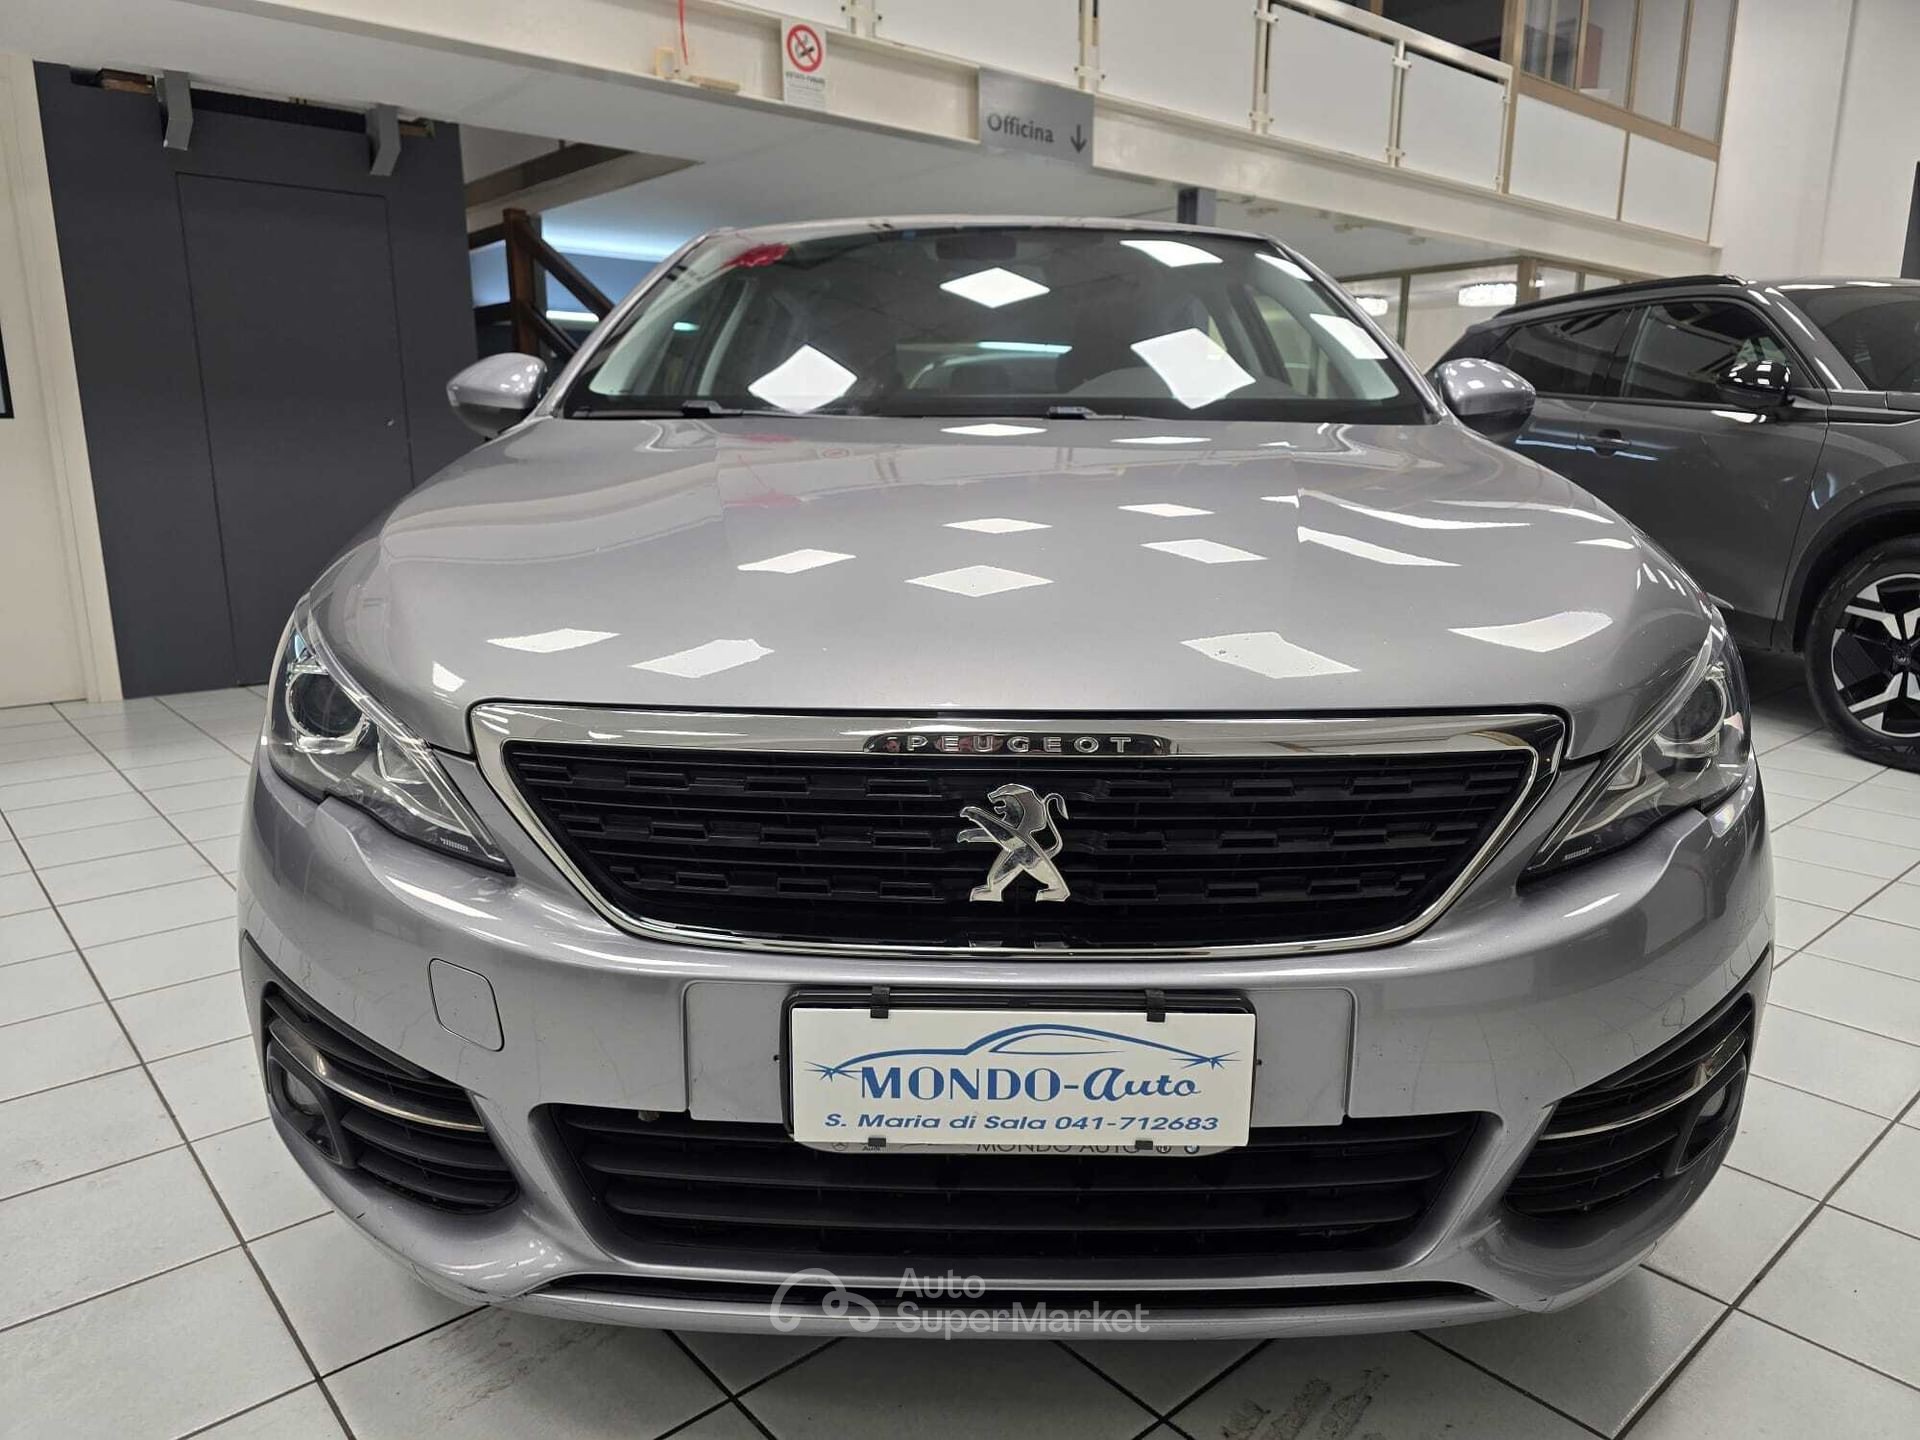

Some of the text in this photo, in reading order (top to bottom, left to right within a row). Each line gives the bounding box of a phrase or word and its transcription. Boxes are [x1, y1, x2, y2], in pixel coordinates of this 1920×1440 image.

[987, 113, 1054, 143] Officina
[906, 735, 1132, 753] PEUGEOT
[861, 1066, 1202, 1101] MONDO-Auto
[825, 1113, 1219, 1131] S. Maria di Sala 041-712683
